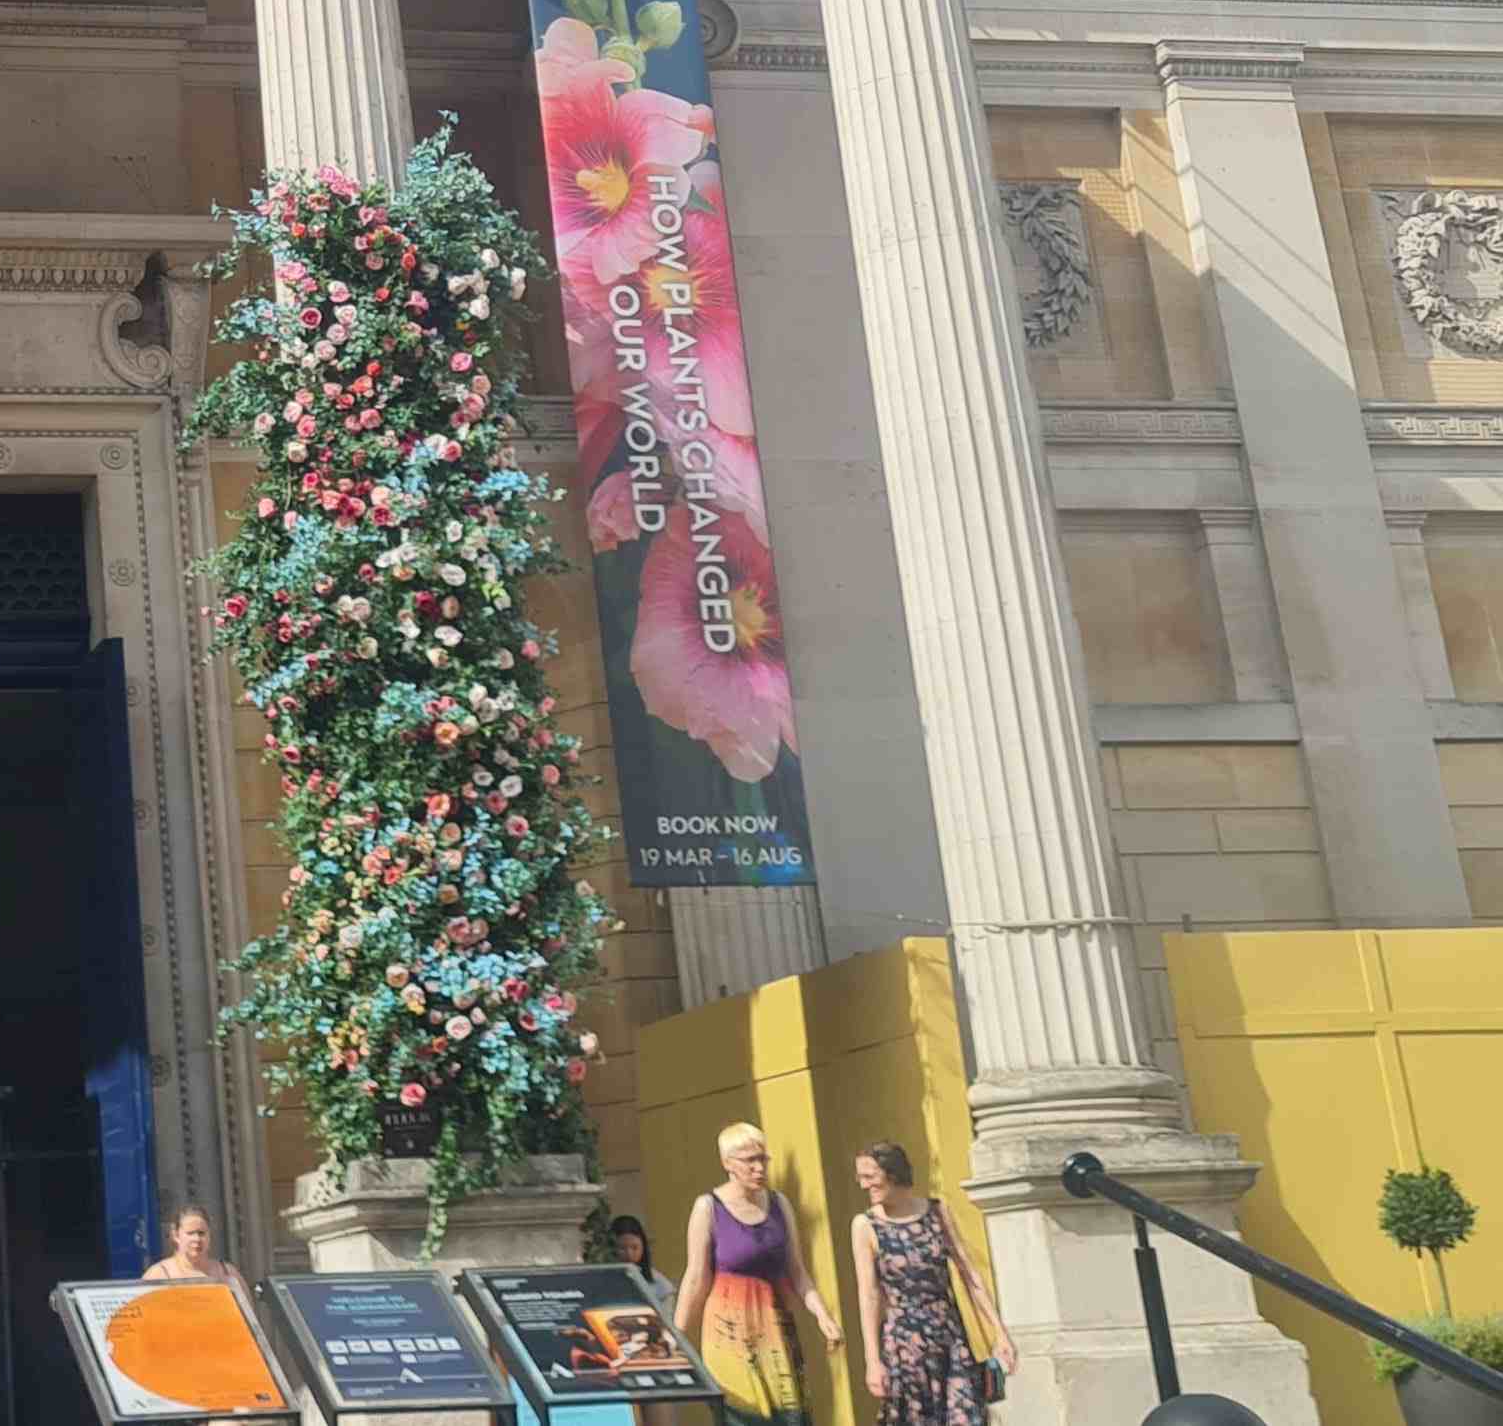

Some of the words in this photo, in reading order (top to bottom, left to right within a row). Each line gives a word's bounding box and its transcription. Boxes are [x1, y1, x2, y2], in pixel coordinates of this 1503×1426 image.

[648, 175, 688, 272] HOW
[609, 284, 647, 371] OUR
[660, 282, 708, 431] PLANTS
[621, 382, 666, 532] WORLD
[680, 441, 736, 653] CHANGED
[640, 847, 660, 866] 19
[665, 847, 713, 866] MAR
[733, 847, 753, 865] 16
[758, 846, 803, 865] AUG
[657, 816, 720, 835] BOOK
[724, 815, 778, 833] NOW
